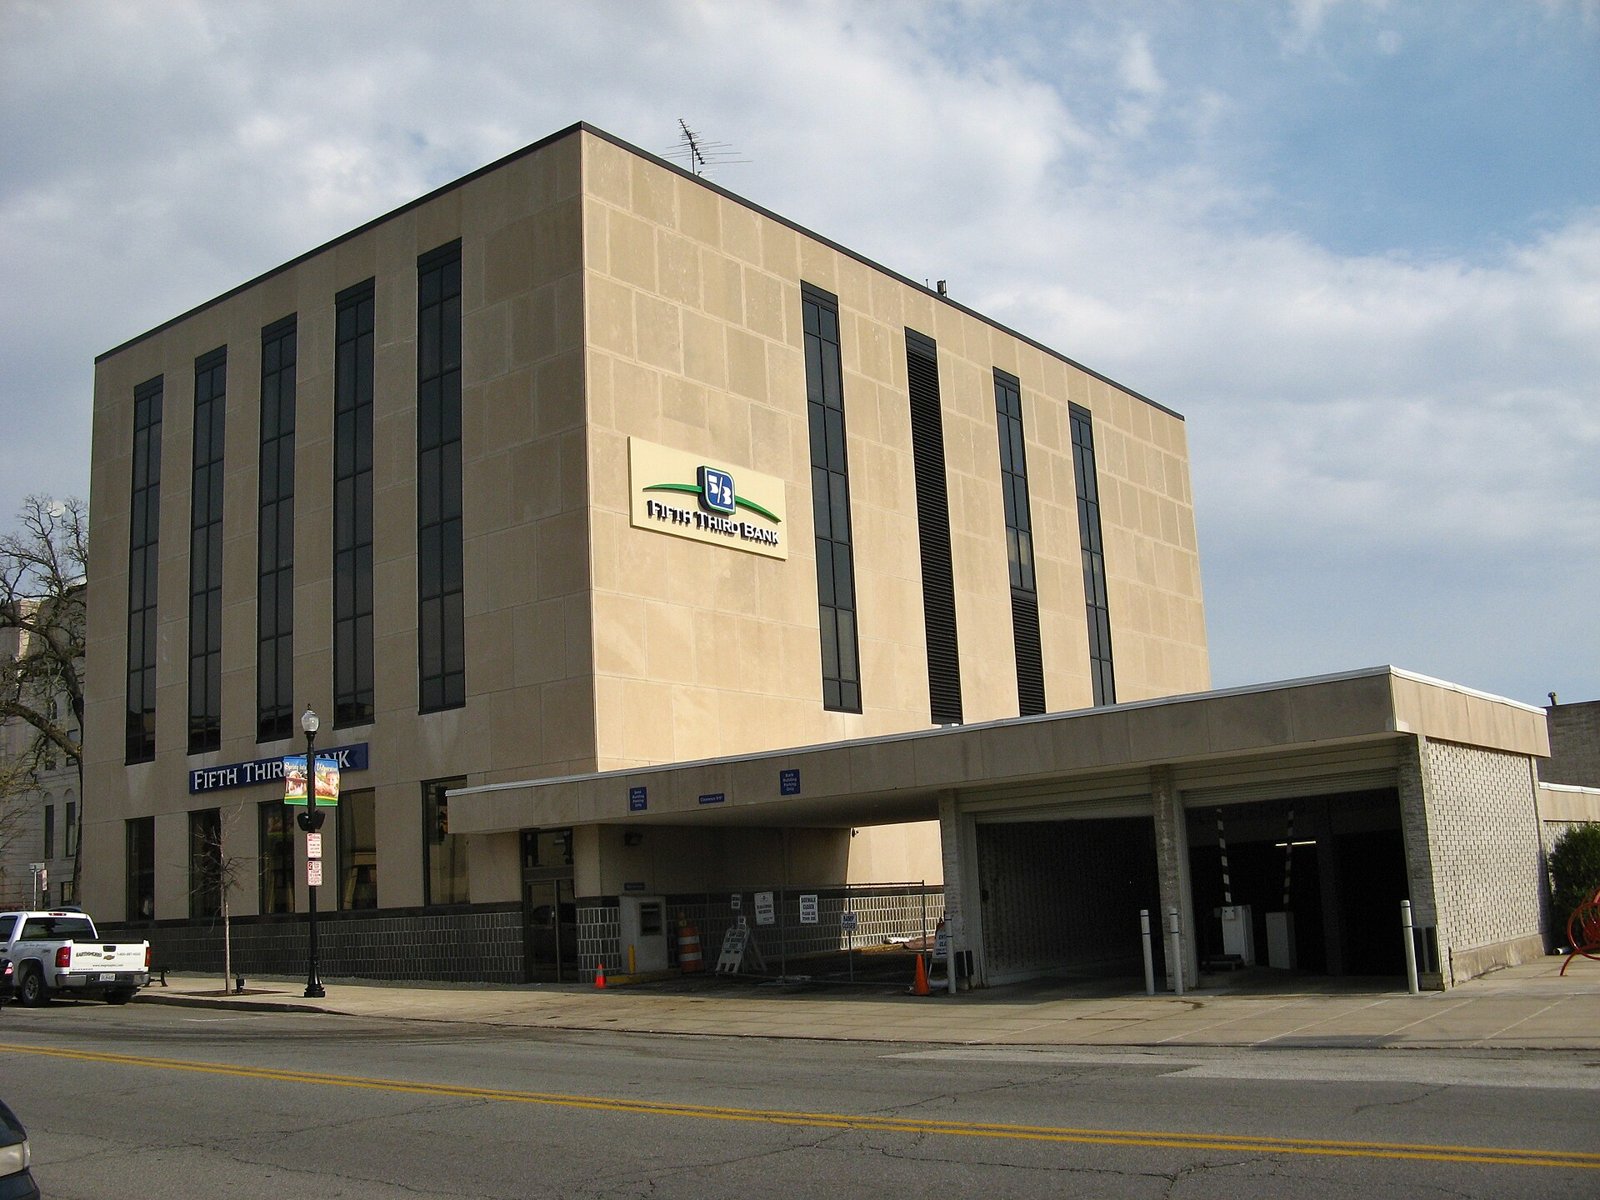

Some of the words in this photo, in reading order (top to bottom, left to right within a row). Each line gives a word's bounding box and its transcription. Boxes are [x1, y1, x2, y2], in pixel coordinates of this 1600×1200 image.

[648, 500, 692, 524] FIFTH
[695, 511, 741, 535] THIRD
[741, 522, 780, 546] BANK
[193, 766, 238, 790] FIFTH
[243, 761, 285, 783] THIR
